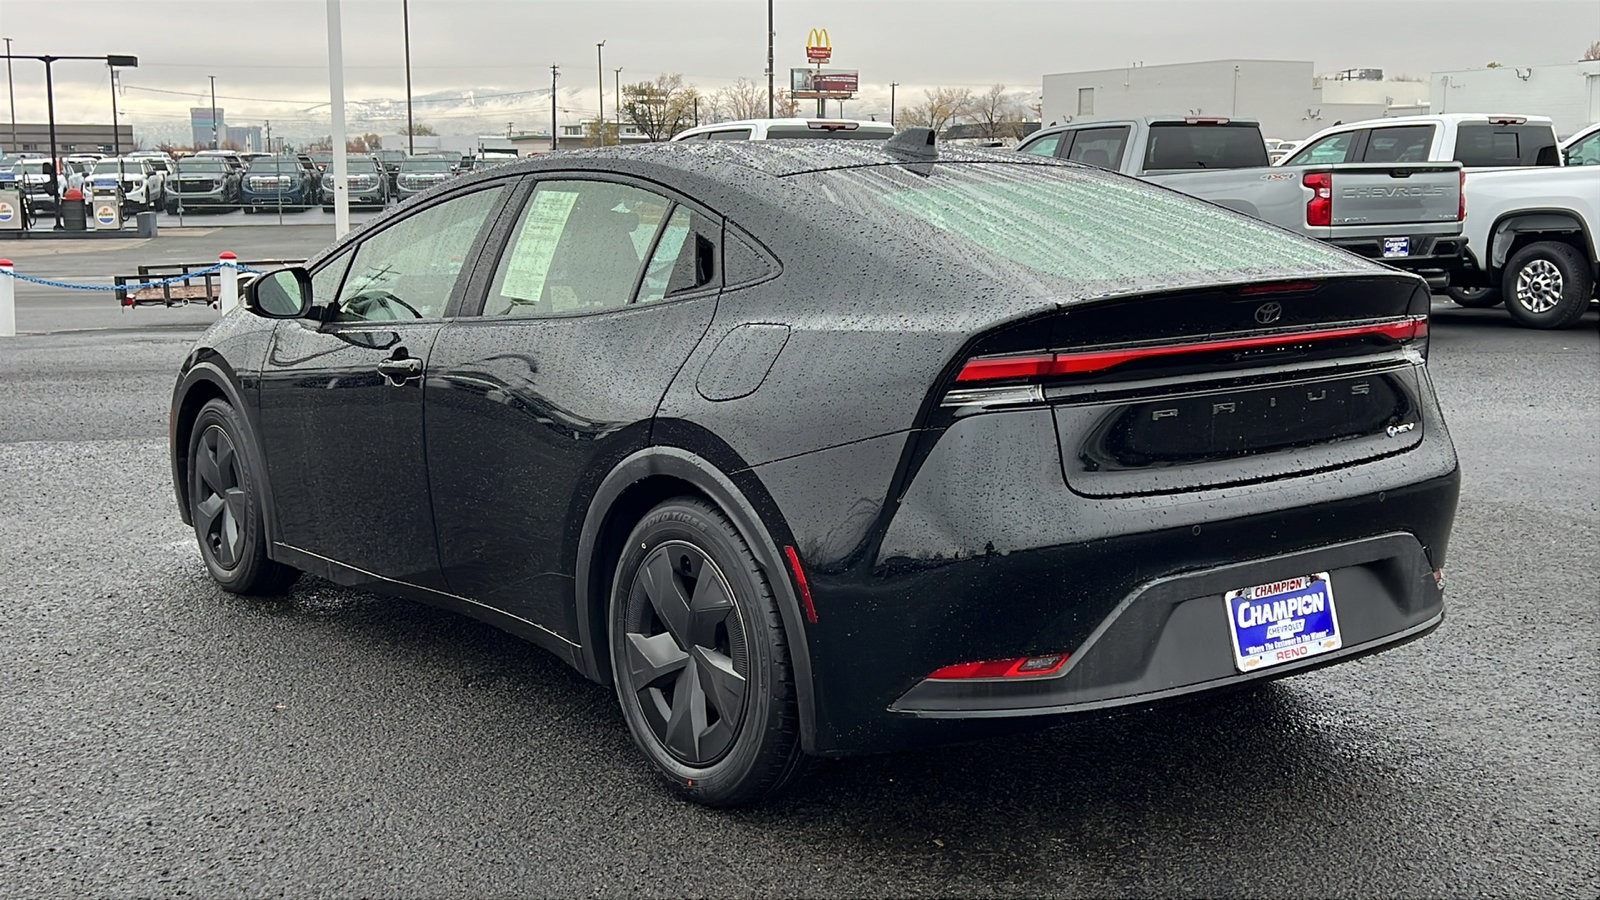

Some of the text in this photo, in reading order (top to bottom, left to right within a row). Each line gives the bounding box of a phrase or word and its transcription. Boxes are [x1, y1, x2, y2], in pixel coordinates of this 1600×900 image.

[1342, 185, 1456, 199] CHEVROLET
[1152, 383, 1370, 421] PRIUS
[1255, 579, 1302, 598] CHAMPION
[1237, 592, 1325, 629] CHAMPION
[1268, 621, 1303, 636] CHEVROLET
[1276, 646, 1308, 660] RENO
